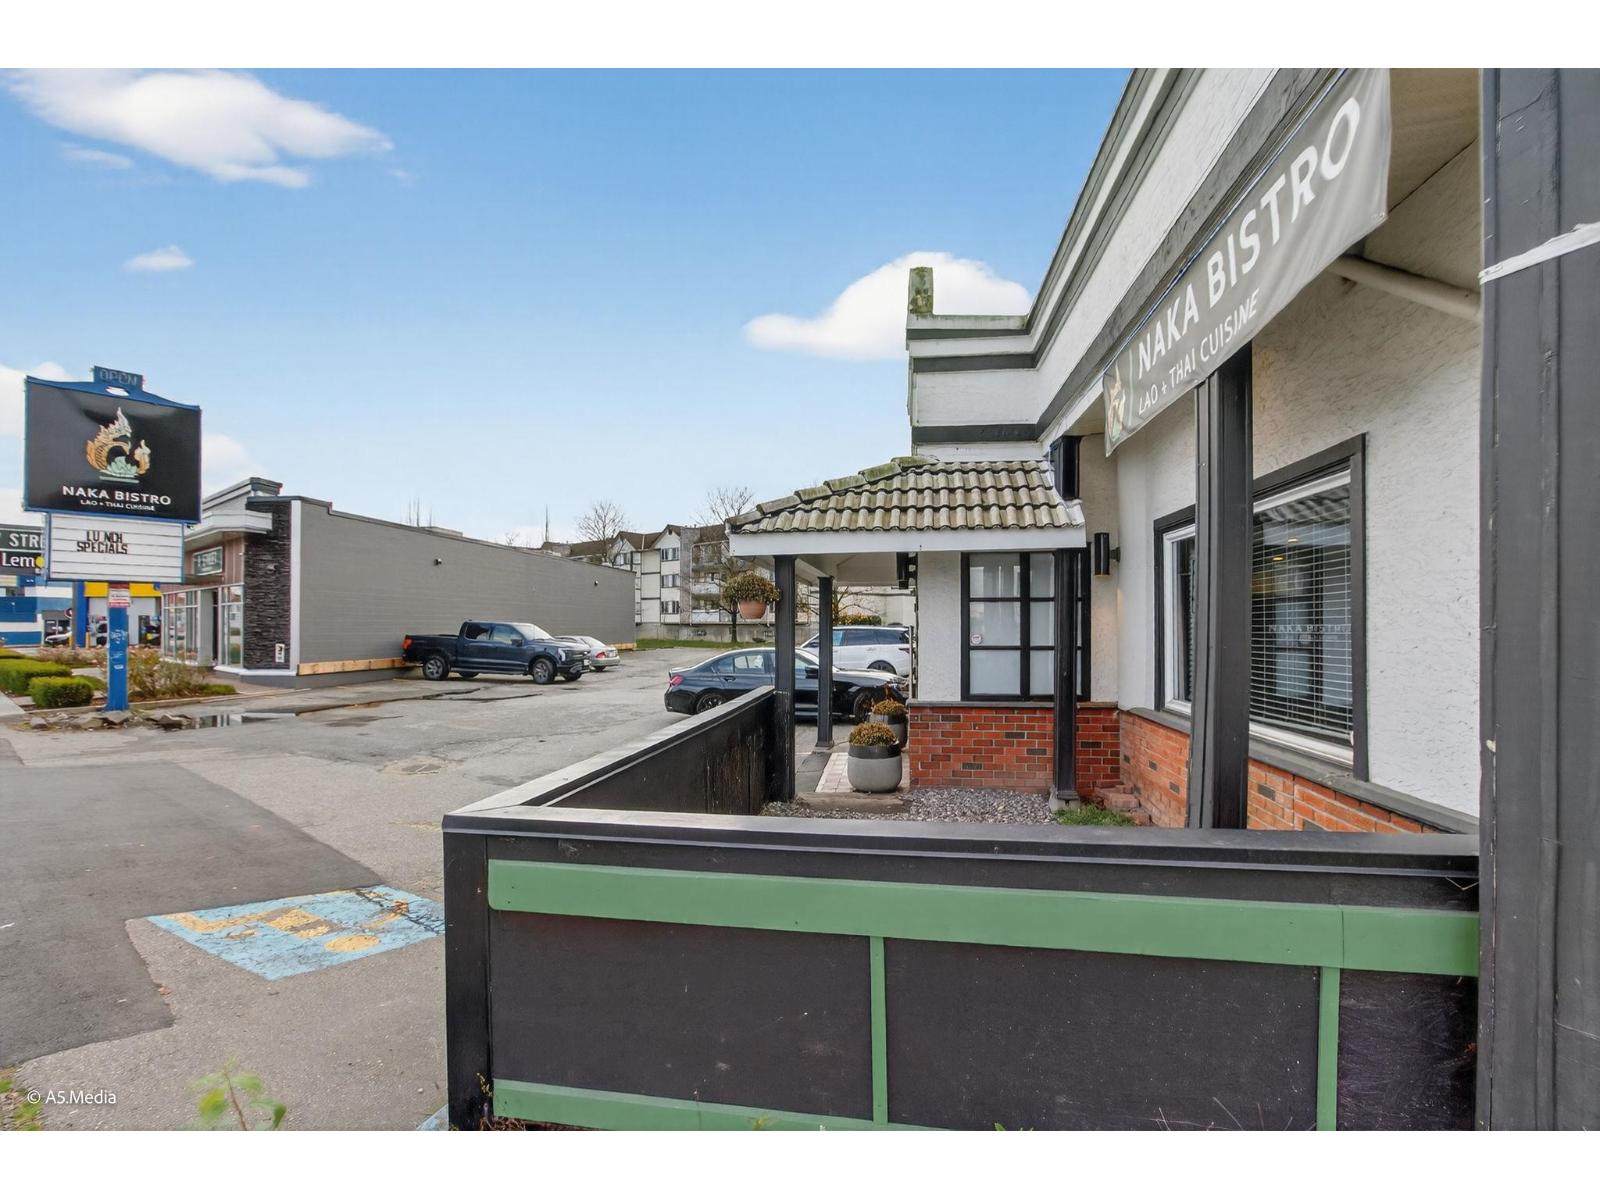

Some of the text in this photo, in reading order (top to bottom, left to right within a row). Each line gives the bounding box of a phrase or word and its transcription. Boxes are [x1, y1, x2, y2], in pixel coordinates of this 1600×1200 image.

[1137, 95, 1361, 381] NAKA BISTRO
[1138, 381, 1158, 416] LAO
[1169, 349, 1196, 392] THAI
[1199, 287, 1260, 363] CUISINE
[62, 485, 171, 505] NAKA BISTRO
[77, 541, 128, 554] SPECIALS
